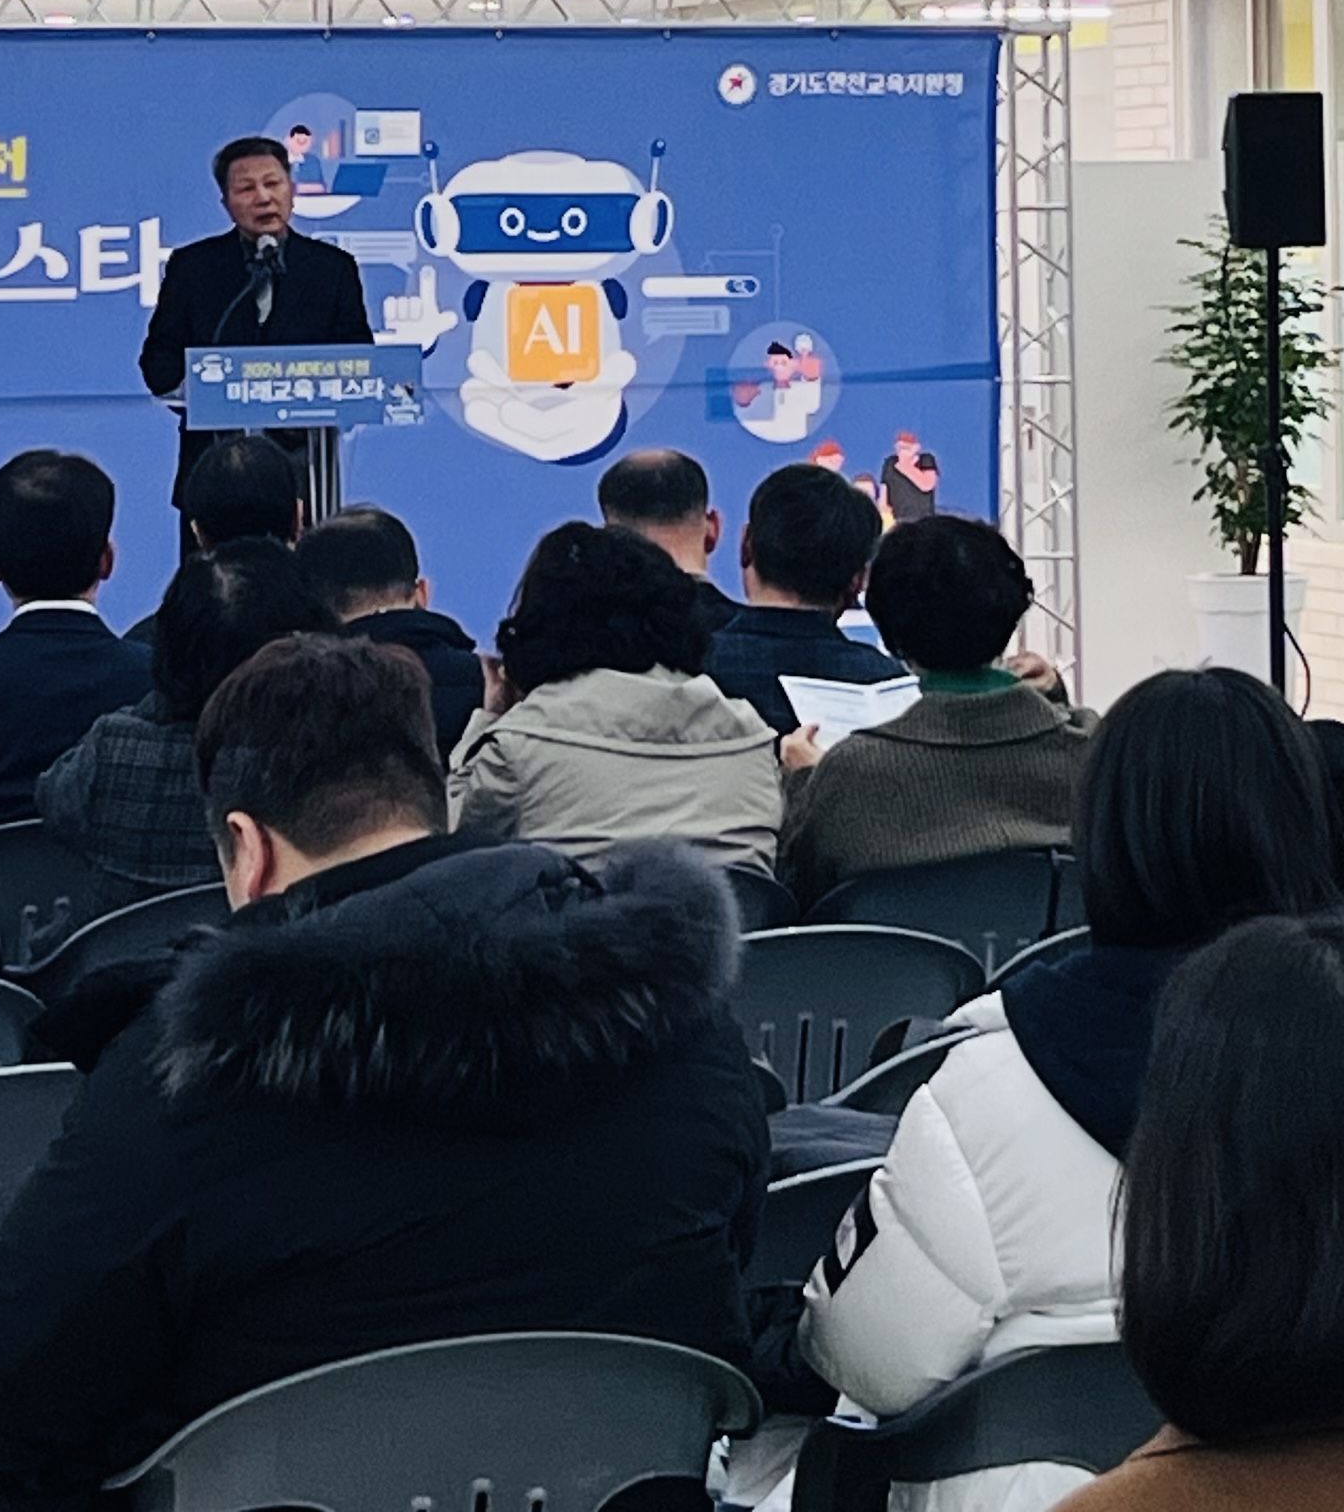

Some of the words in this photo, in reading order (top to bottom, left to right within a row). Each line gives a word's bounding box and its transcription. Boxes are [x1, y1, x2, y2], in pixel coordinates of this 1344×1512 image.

[768, 71, 964, 97] 경기도연천교육지원청
[523, 303, 581, 355] AI
[226, 378, 314, 403] 미래교육
[319, 376, 385, 402] 페스타
